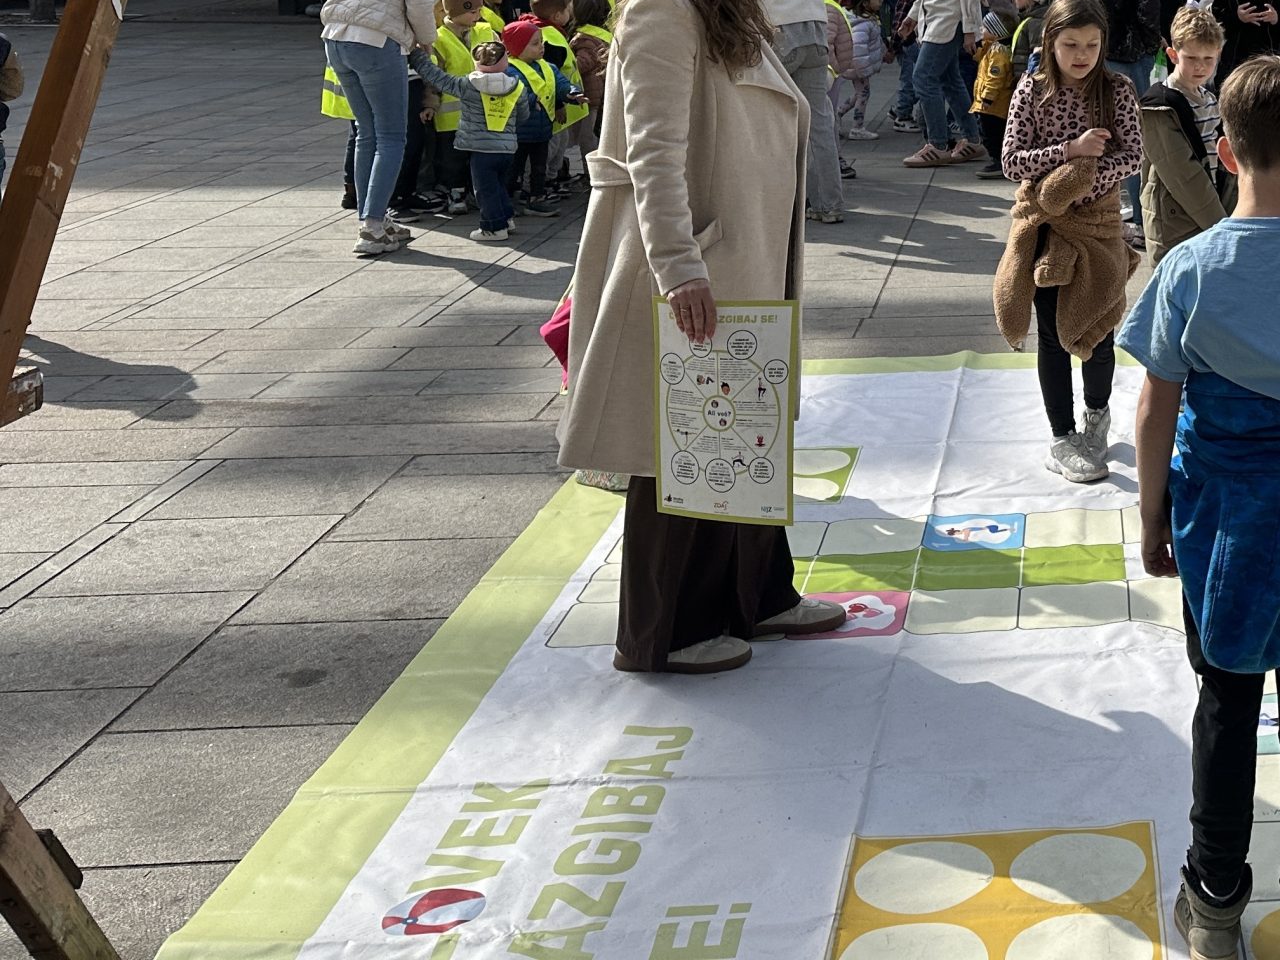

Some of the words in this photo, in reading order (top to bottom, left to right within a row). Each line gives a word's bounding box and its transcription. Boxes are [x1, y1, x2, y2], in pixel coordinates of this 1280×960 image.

[715, 314, 758, 324] ZGIBAJ
[760, 314, 778, 324] SE!
[506, 725, 694, 960] AZGIBAJ
[649, 902, 753, 960] E!
